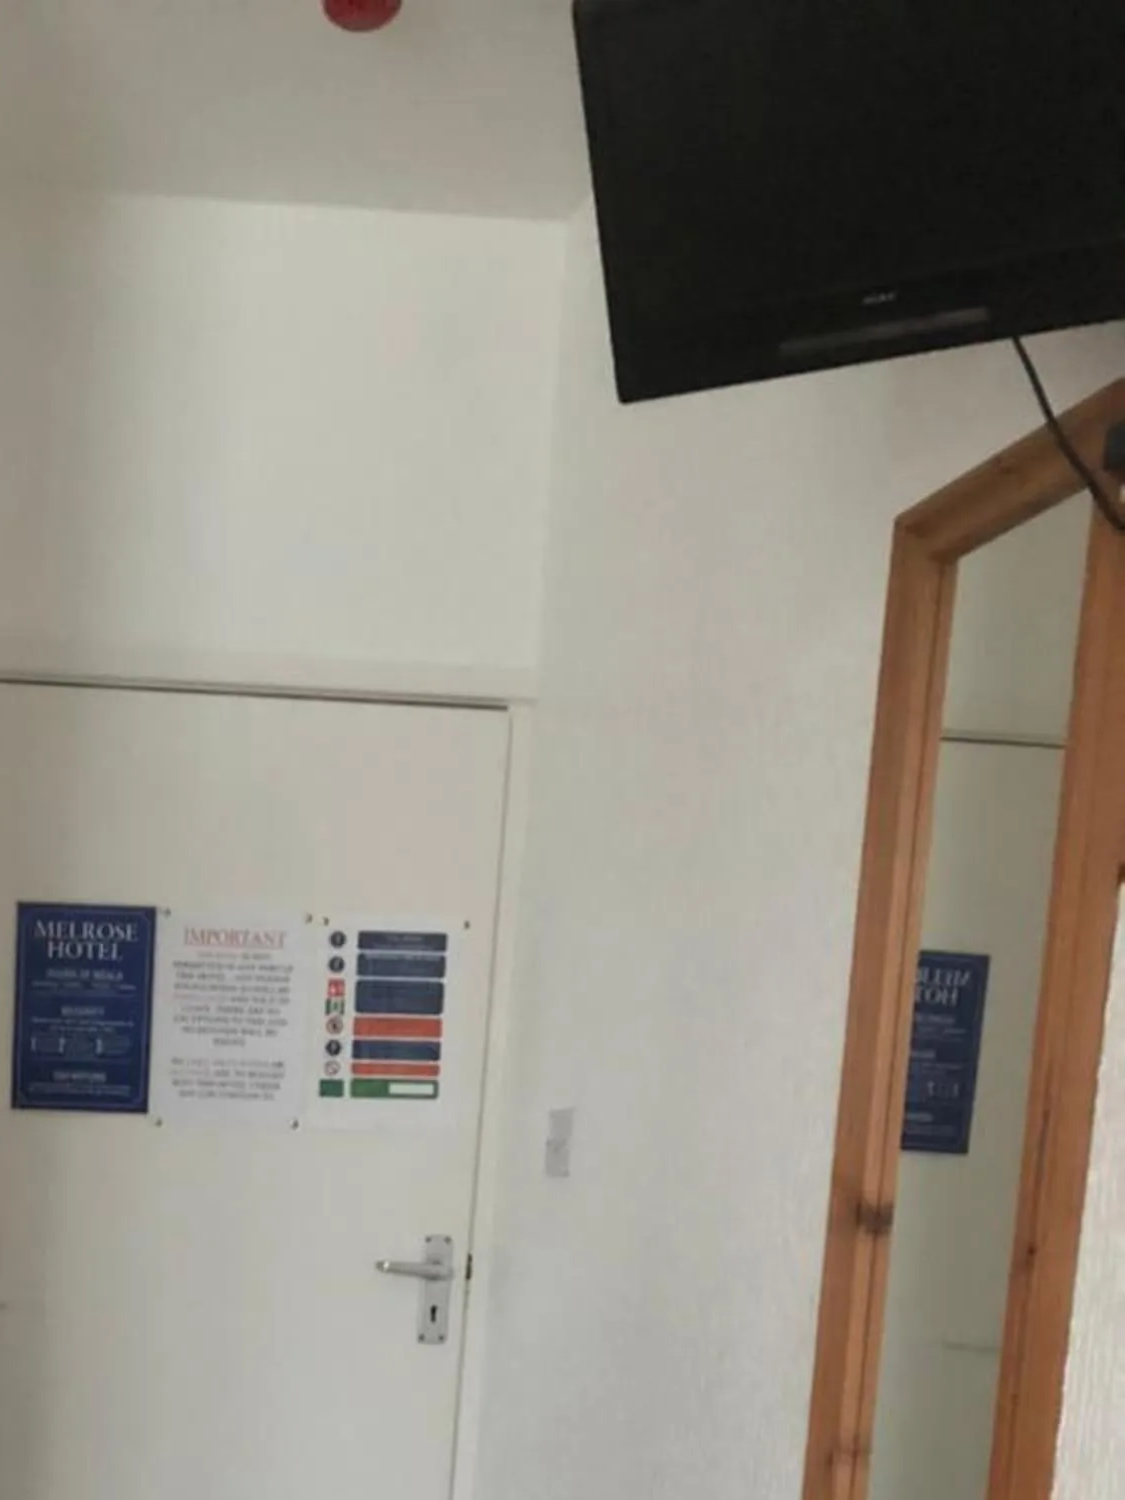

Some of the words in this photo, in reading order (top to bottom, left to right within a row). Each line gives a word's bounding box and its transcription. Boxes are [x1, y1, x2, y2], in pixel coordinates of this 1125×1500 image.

[34, 919, 138, 942] MELROSE
[184, 927, 286, 948] IMPORTANT
[47, 941, 123, 961] HOTEL
